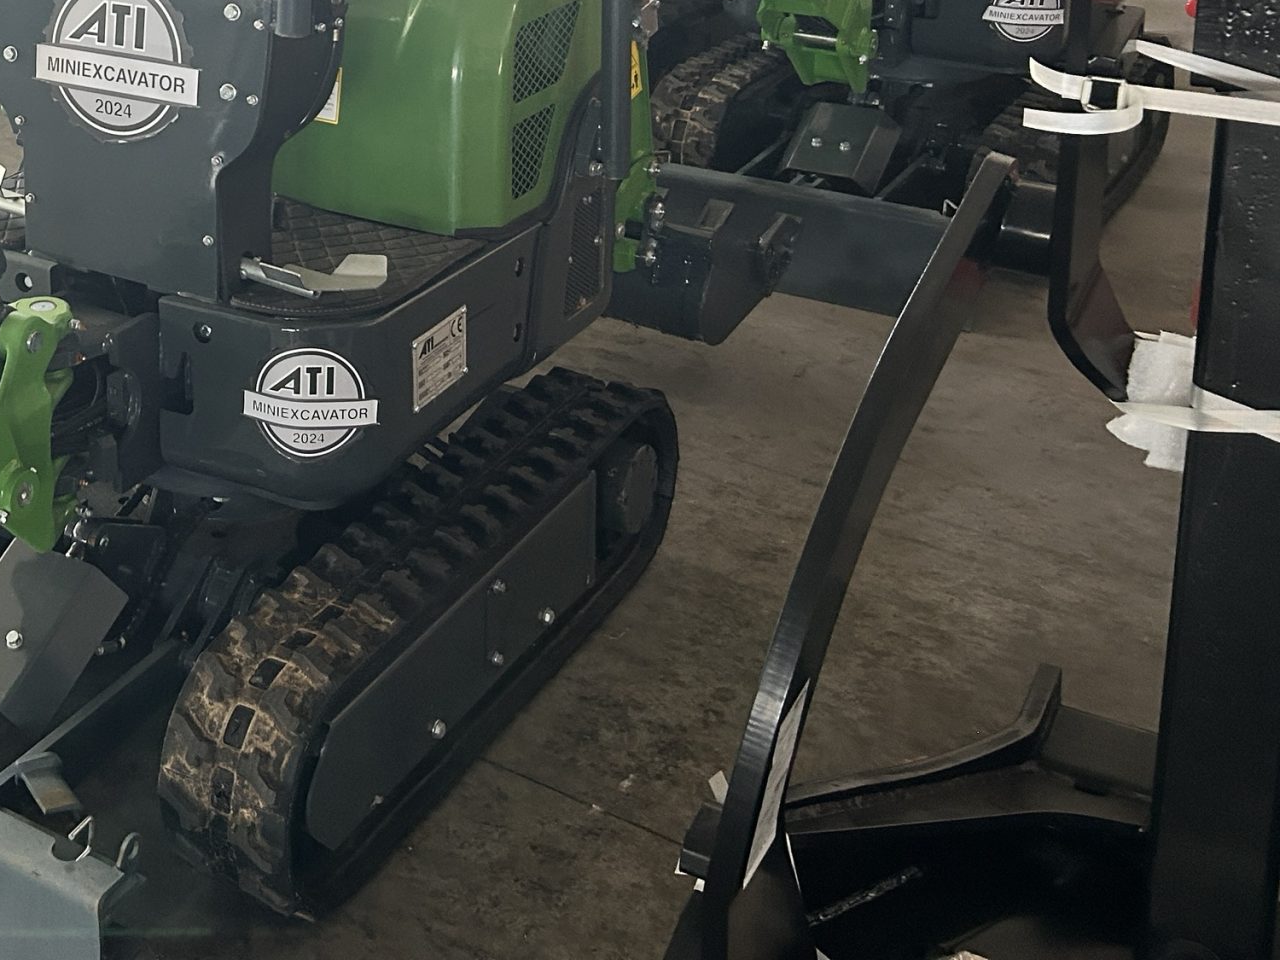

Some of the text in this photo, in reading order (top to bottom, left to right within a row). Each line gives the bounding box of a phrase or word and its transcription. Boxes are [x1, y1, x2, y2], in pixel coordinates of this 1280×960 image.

[66, 0, 147, 51] ATI
[988, 9, 1061, 22] MINIEXCAVATOR
[47, 56, 186, 94] MINIEXCAVATOR
[95, 98, 132, 119] 2024
[269, 365, 336, 396] ATI
[252, 400, 368, 421] MINIEXCAVATOR
[292, 432, 325, 444] 2024
